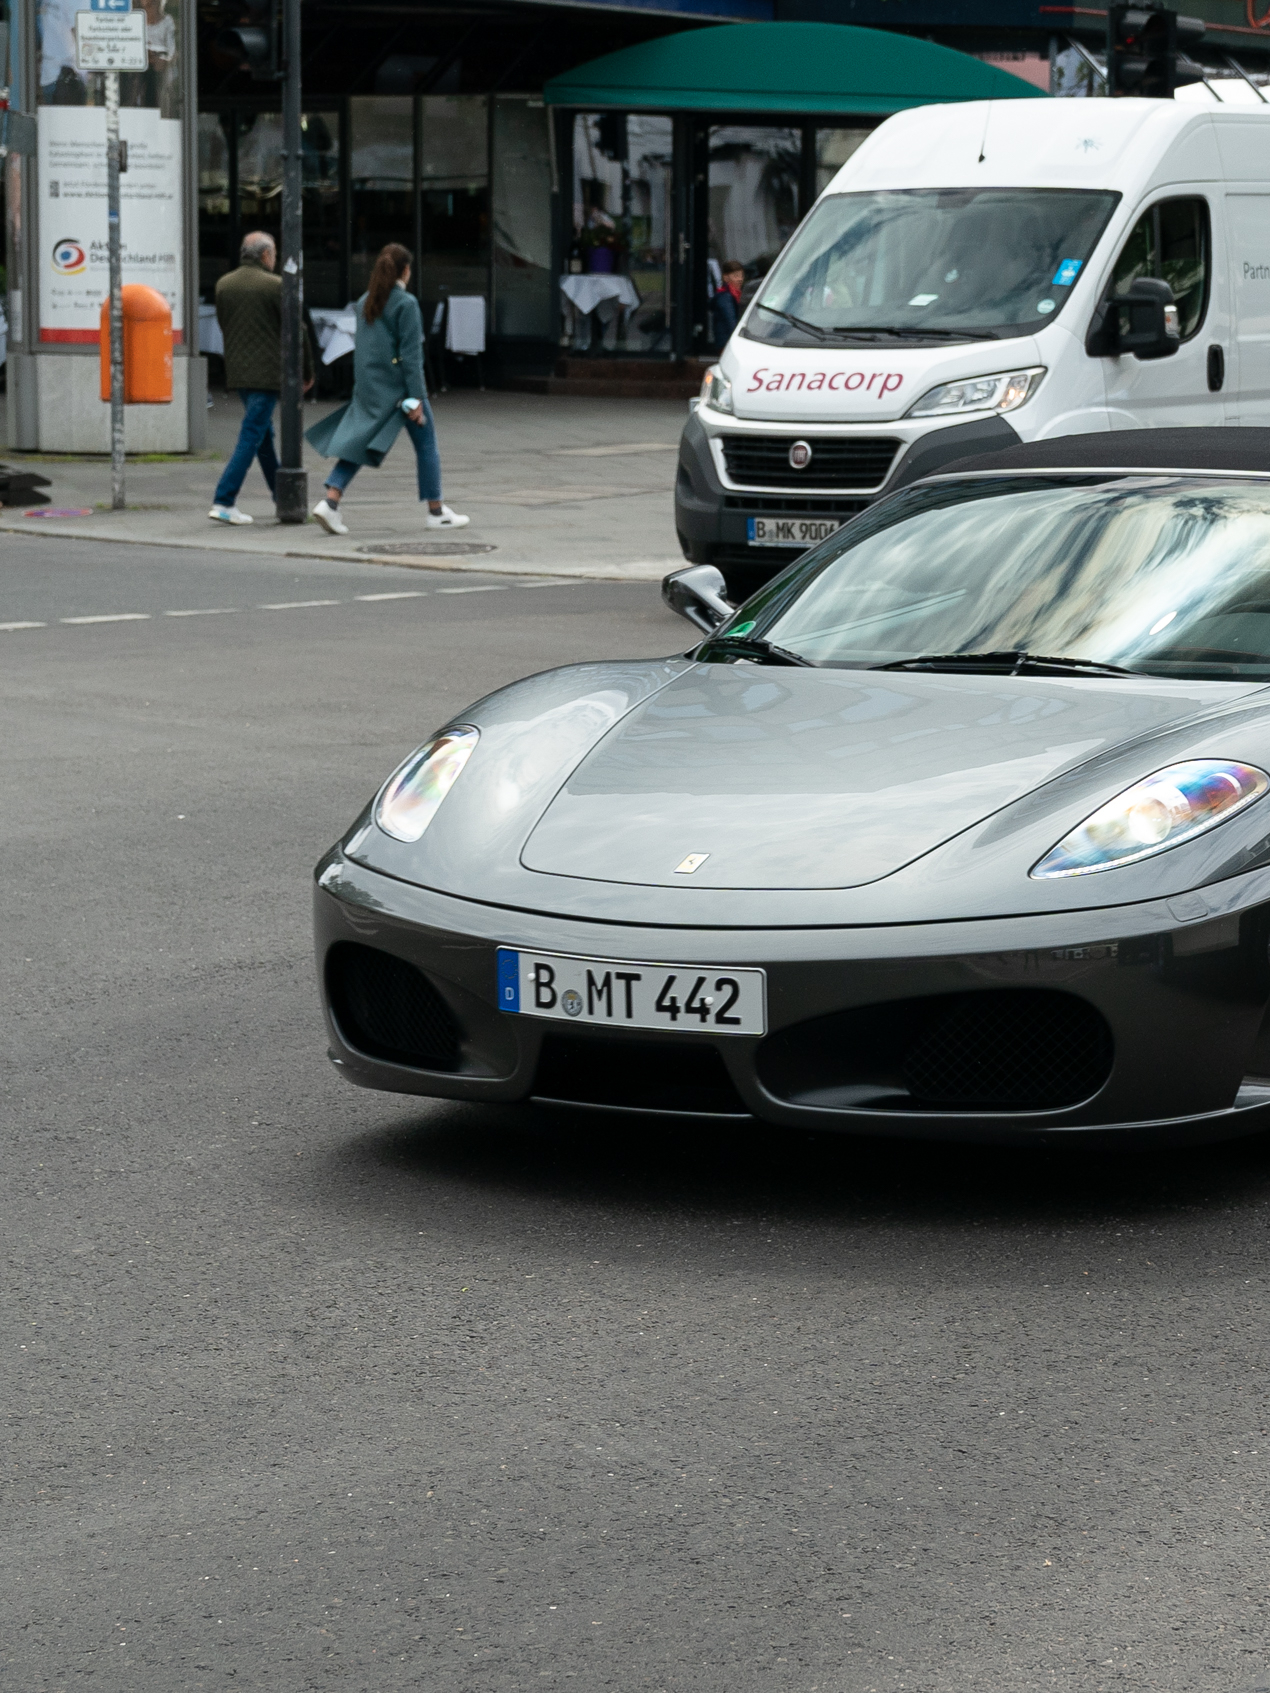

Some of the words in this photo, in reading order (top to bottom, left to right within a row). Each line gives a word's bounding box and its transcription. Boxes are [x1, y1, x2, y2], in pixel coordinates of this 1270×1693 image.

[746, 368, 904, 399] Sanacorp
[756, 521, 766, 539] B
[776, 521, 796, 540] MK
[504, 987, 515, 1001] D
[534, 962, 558, 1010] B
[586, 969, 642, 1019] MT
[655, 974, 741, 1026] 442
